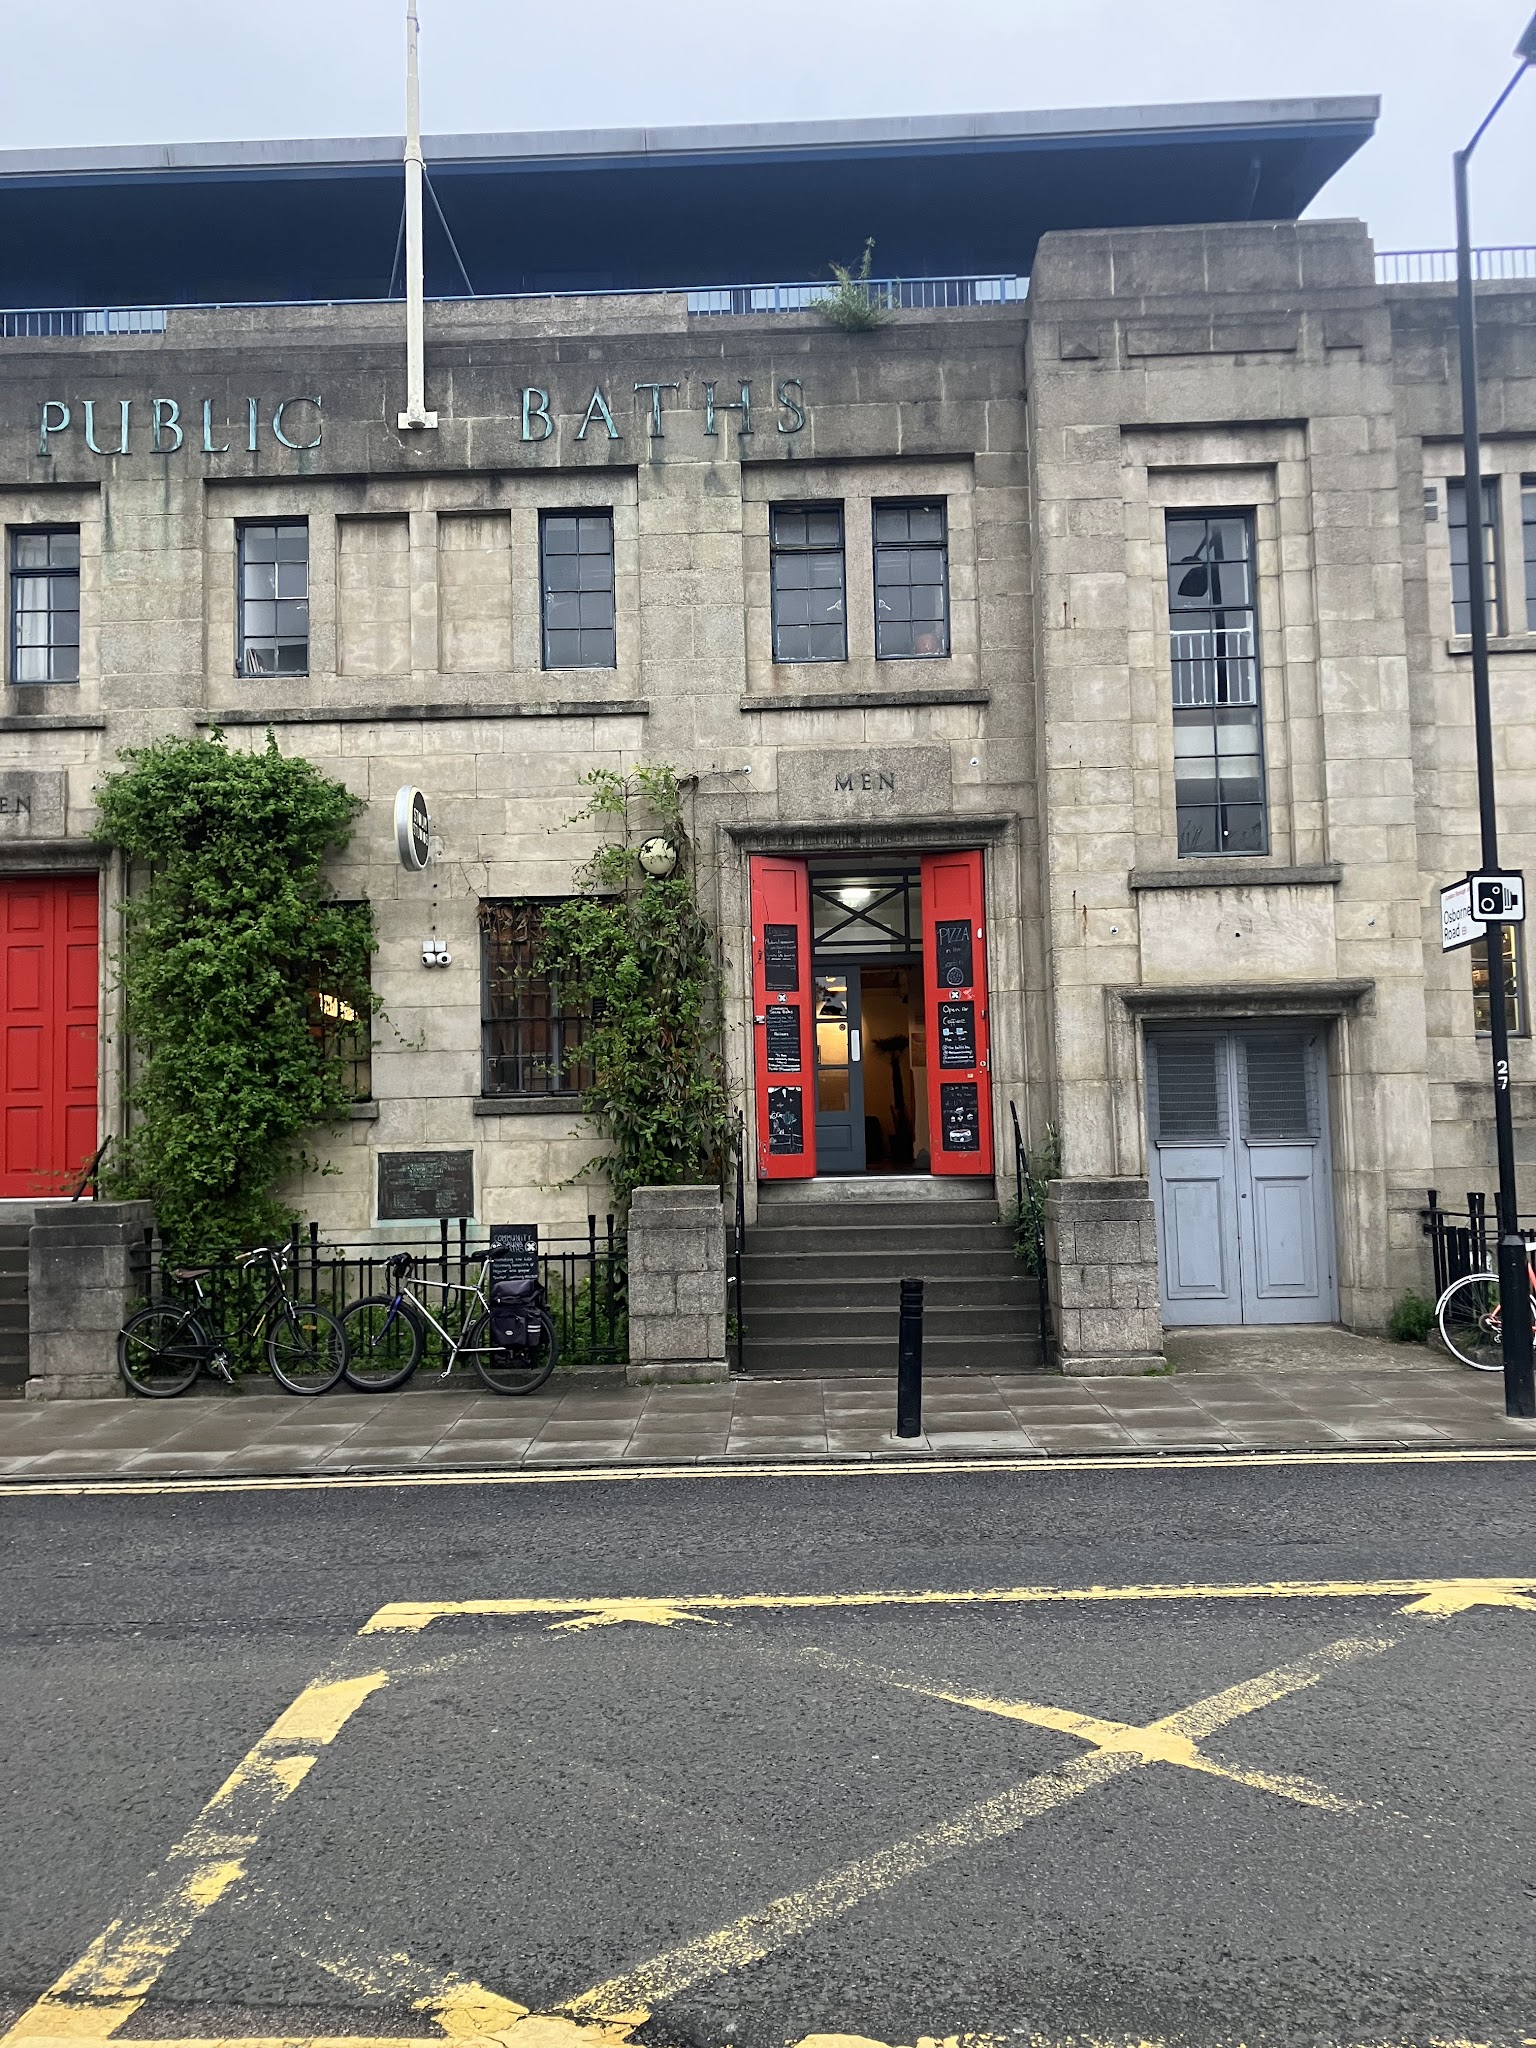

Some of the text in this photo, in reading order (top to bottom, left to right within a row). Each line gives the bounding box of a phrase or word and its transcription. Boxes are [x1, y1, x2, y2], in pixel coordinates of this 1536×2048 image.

[36, 378, 807, 457] PUBLIC BATHS
[834, 772, 896, 791] MEN
[0, 796, 31, 813] EN
[1444, 906, 1471, 925] Osborne
[939, 927, 969, 945] PIZZA
[1444, 922, 1460, 941] Road
[942, 1004, 961, 1014] Open
[1496, 1059, 1508, 1090] 27
